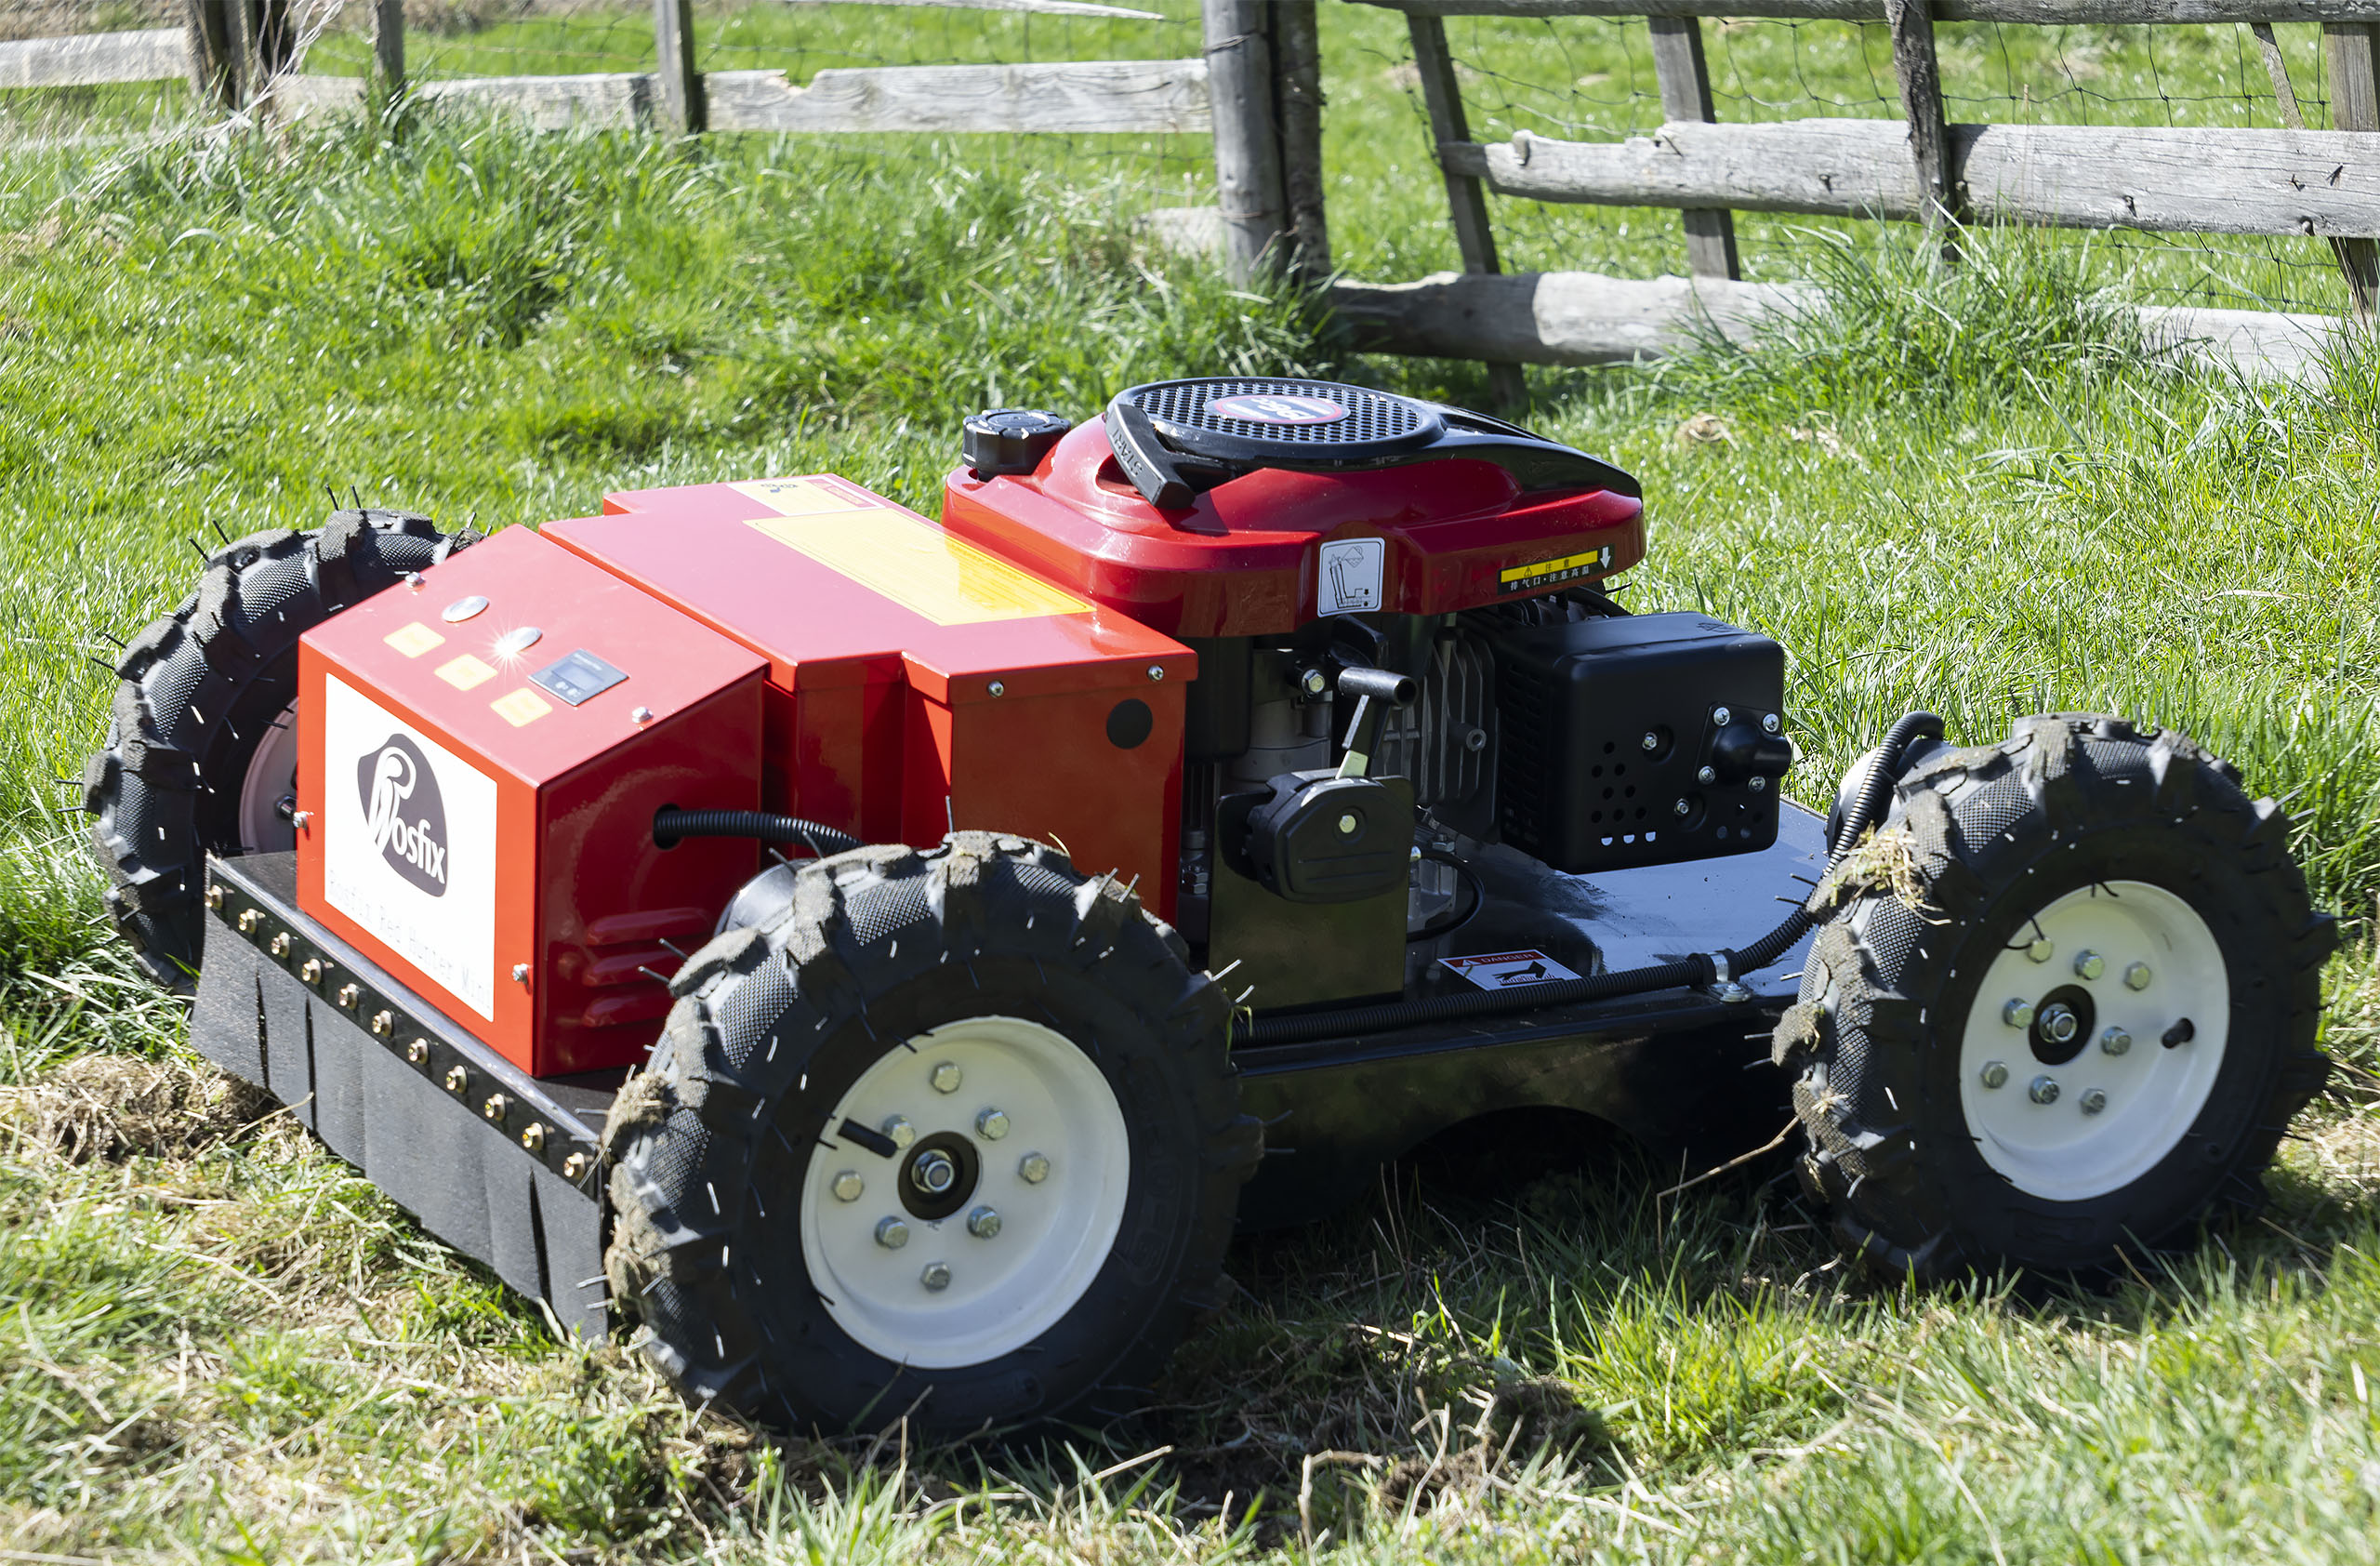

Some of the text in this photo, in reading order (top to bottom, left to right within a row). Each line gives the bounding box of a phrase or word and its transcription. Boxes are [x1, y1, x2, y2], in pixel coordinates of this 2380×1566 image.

[1113, 429, 1143, 478] START
[369, 746, 447, 884] Rosfix
[1480, 952, 1534, 964] DANGER
